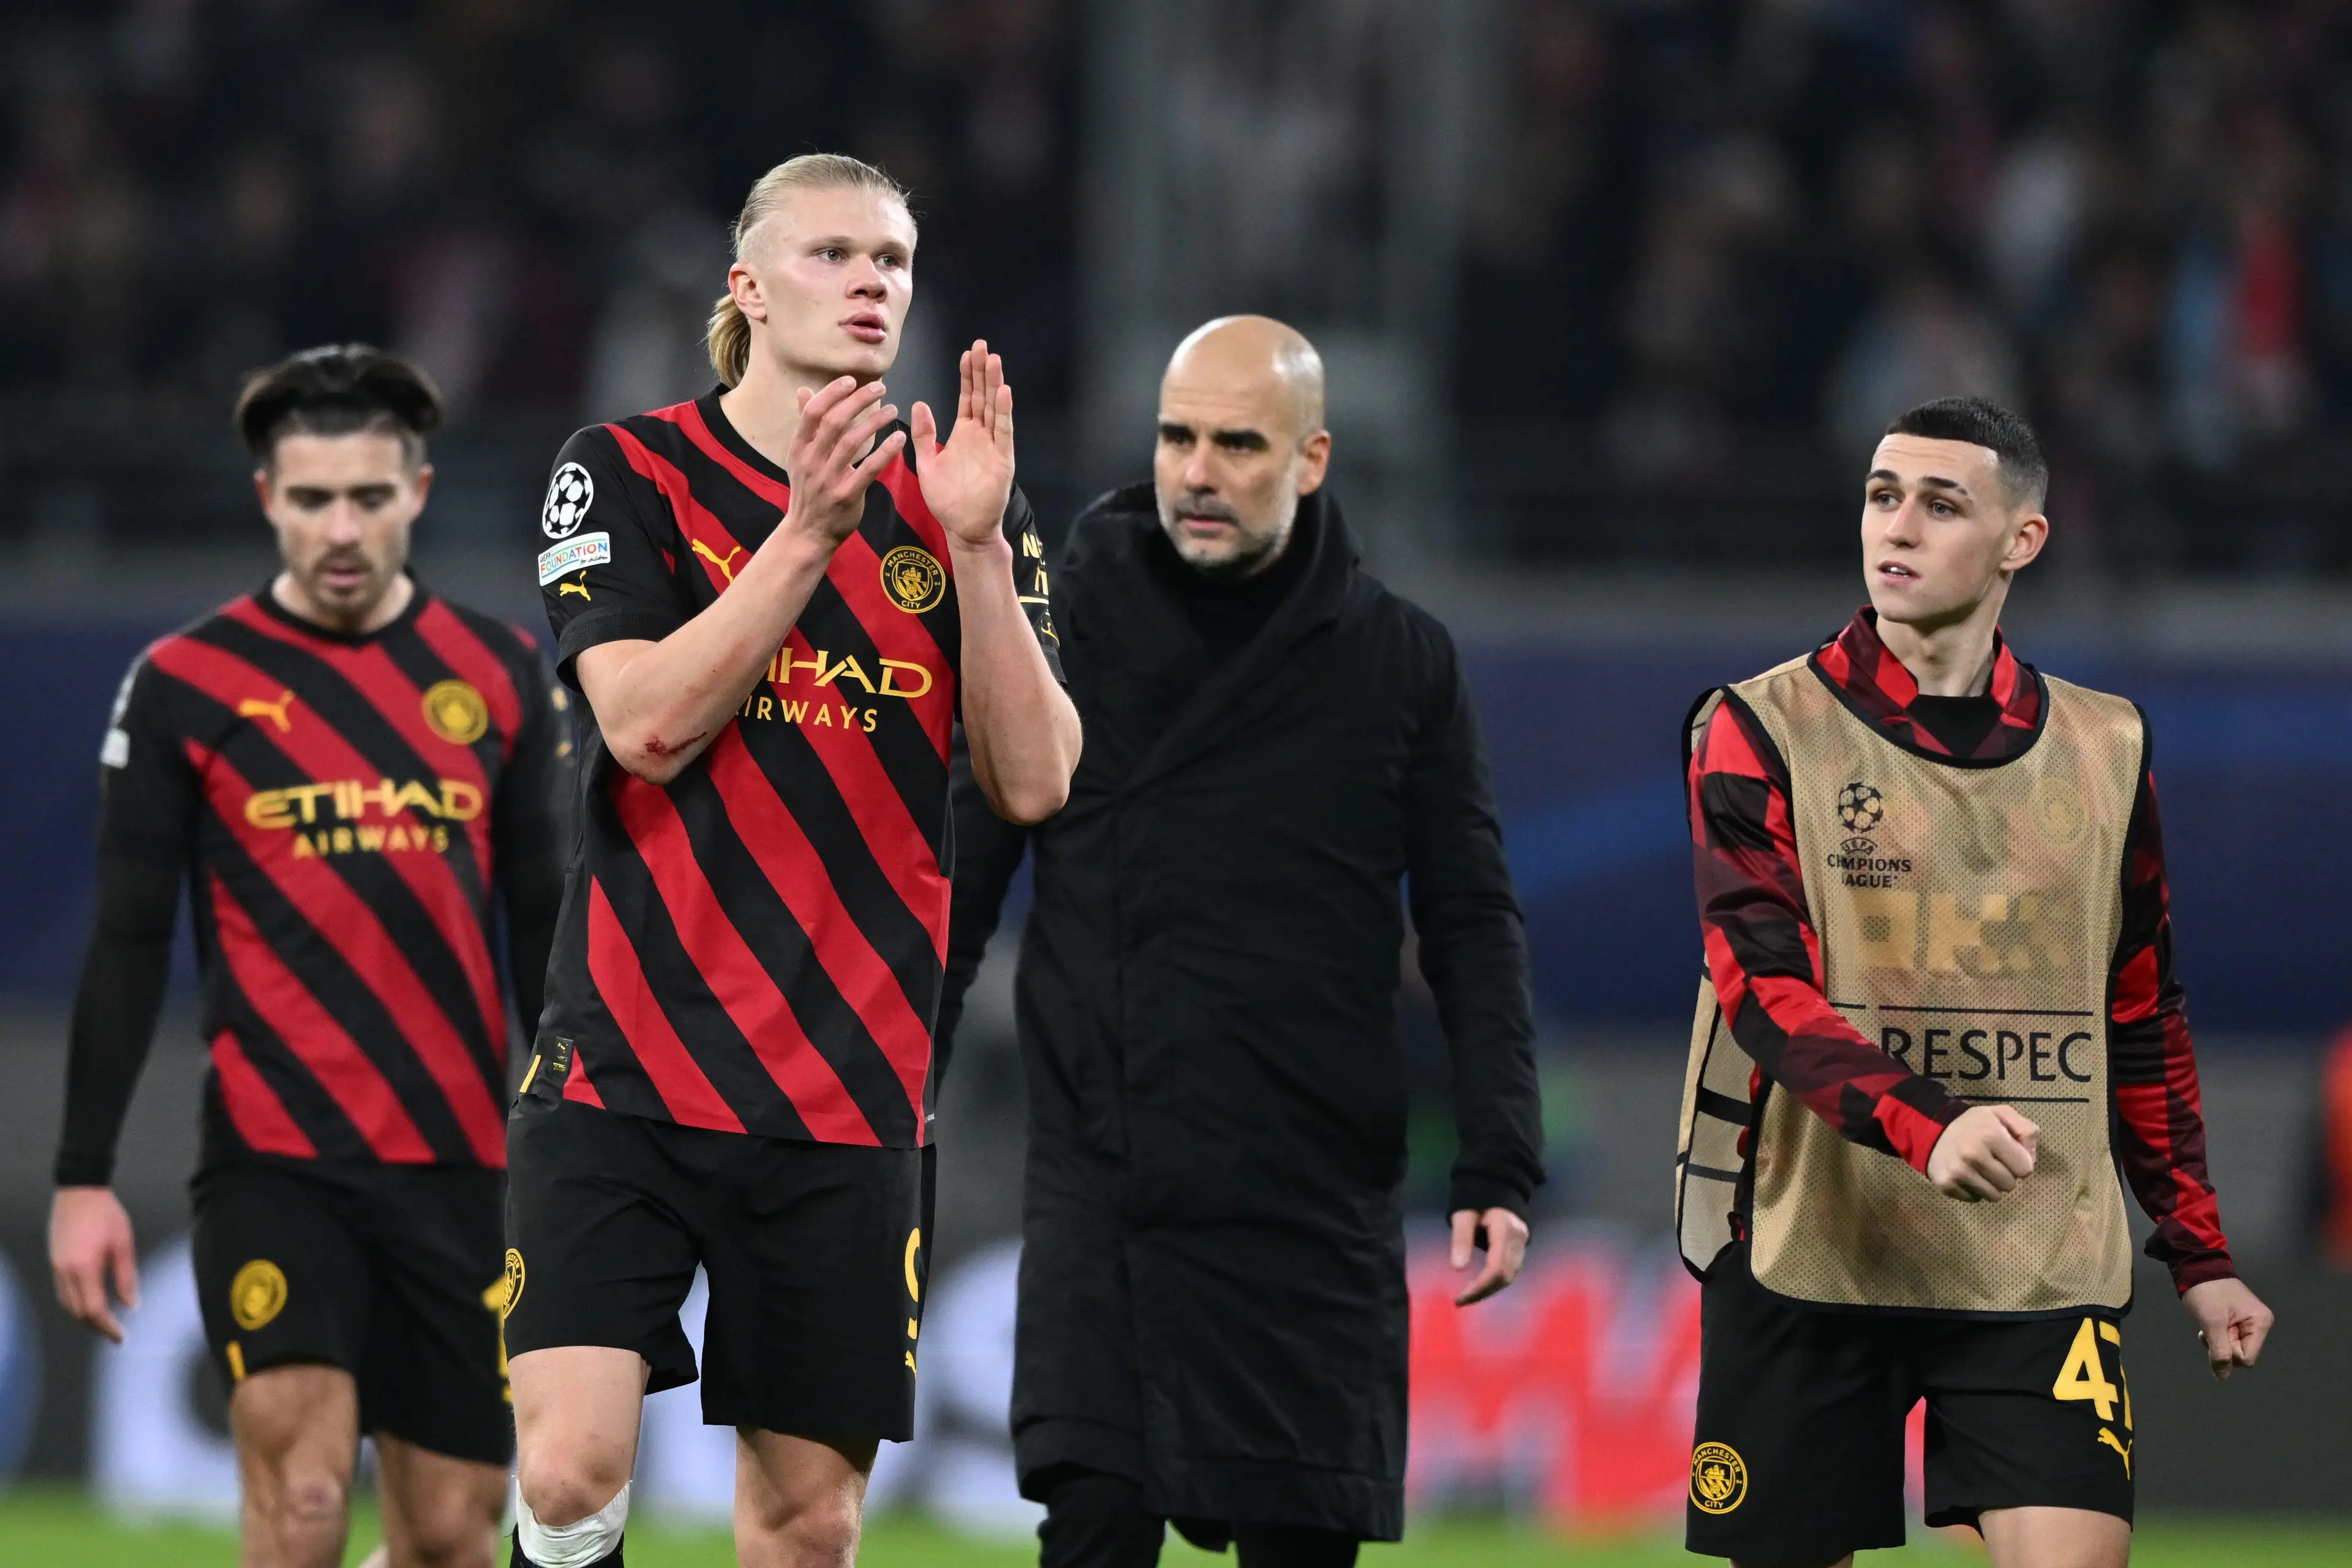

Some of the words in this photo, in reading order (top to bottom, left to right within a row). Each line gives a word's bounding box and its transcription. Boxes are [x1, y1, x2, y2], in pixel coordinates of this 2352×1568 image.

[540, 543, 608, 575] FOUNDATION
[888, 551, 938, 576] MANCHESTER
[901, 600, 921, 609] CITY
[767, 647, 932, 698] IHAD
[736, 695, 878, 732] IRWAYS
[245, 778, 483, 829] ETIHAD
[293, 825, 450, 859] AIRWAYS
[1841, 840, 1874, 855] UEFA
[1827, 854, 1912, 872] CHMPIONS
[1842, 873, 1893, 888] AGUE
[1693, 1448, 1741, 1472] MANCHESTER
